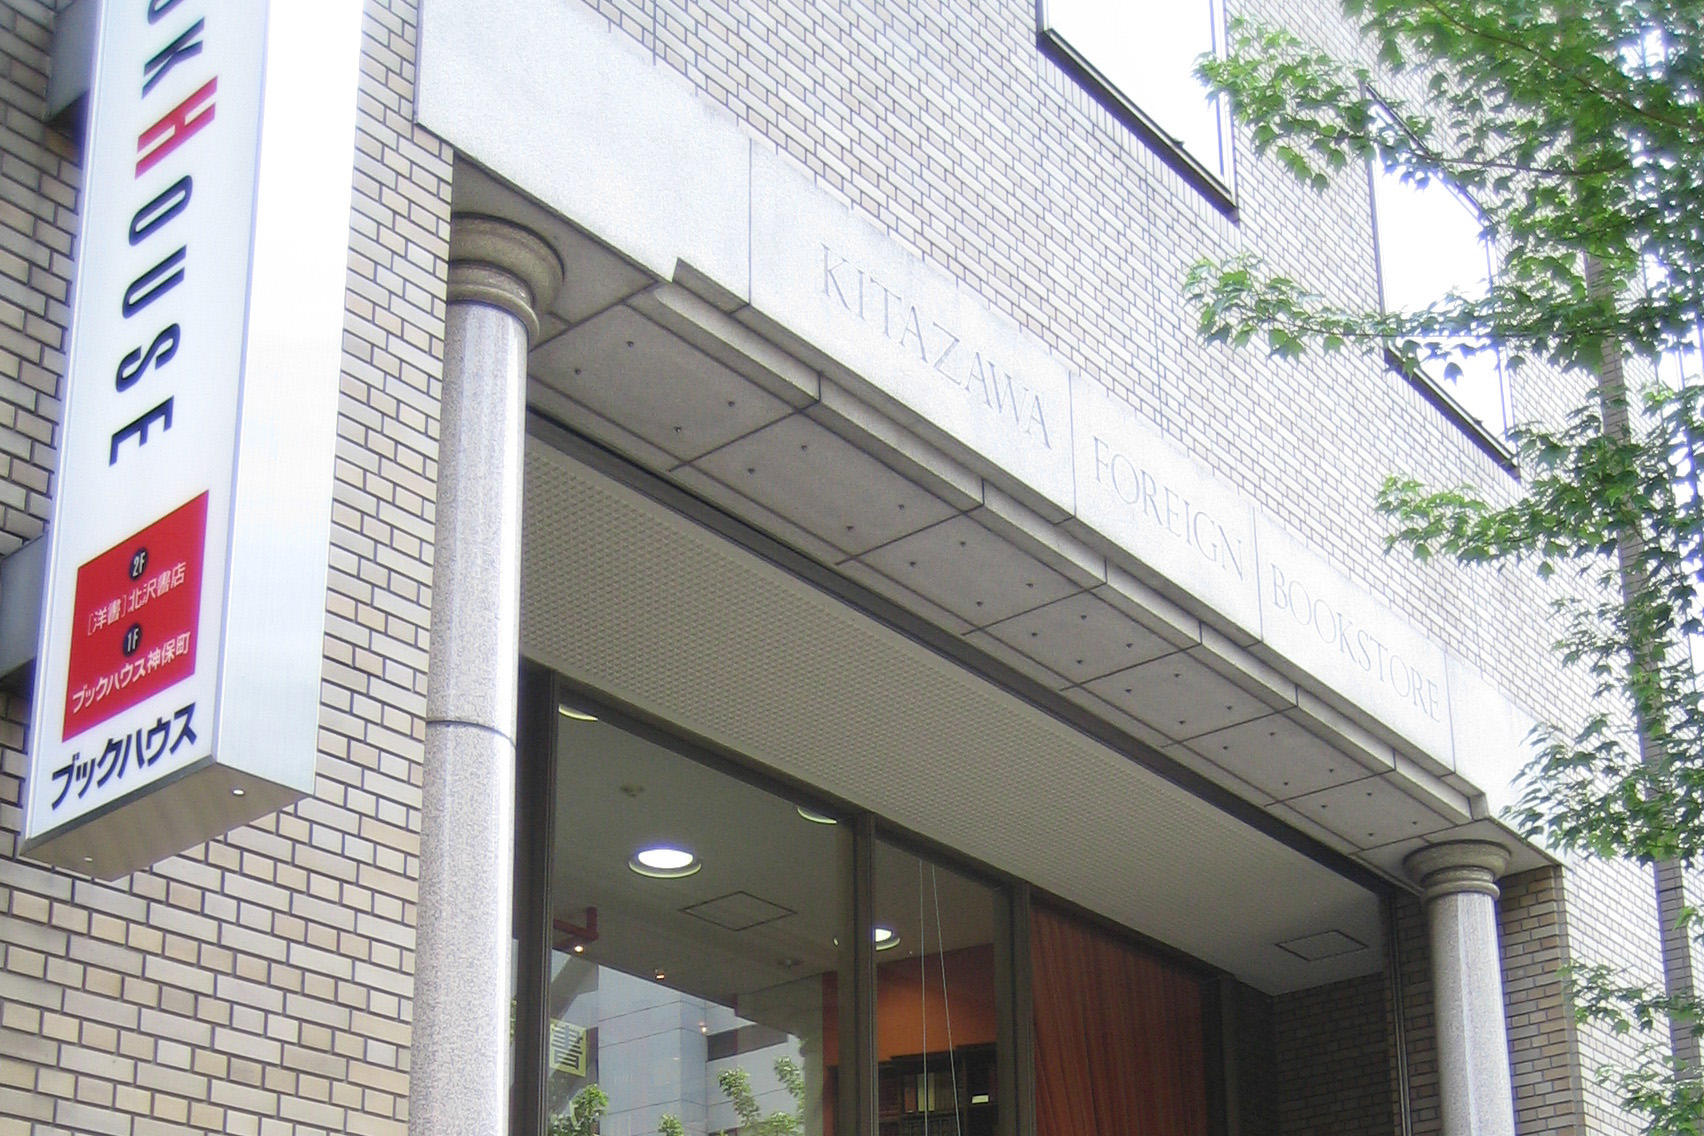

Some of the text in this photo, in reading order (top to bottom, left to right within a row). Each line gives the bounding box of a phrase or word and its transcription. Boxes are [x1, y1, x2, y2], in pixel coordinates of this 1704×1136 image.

[821, 243, 1441, 723] KITAZAWA FOREIGN BOOKSTORE
[132, 551, 147, 577] 2F
[72, 631, 192, 714] ブックハウス神保町
[127, 627, 140, 653] 1F
[52, 701, 198, 811] ブックハウス
